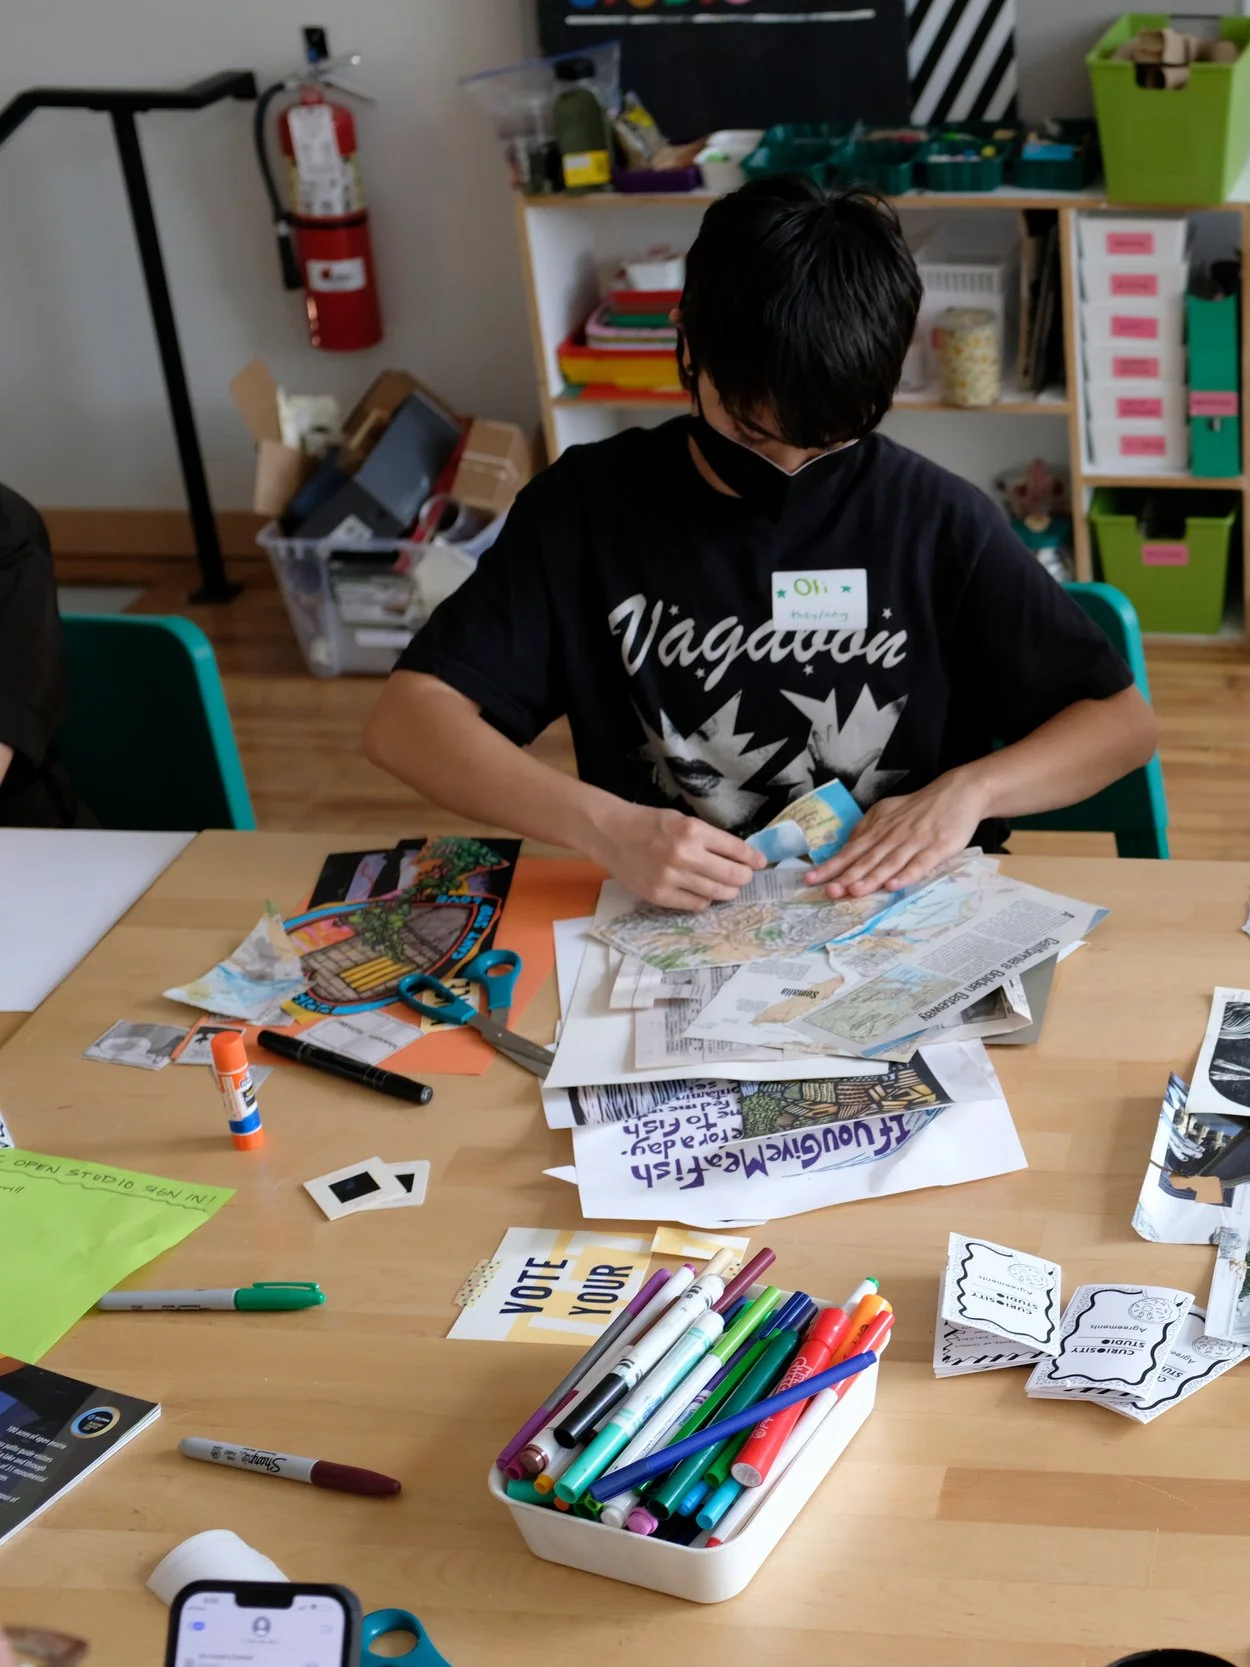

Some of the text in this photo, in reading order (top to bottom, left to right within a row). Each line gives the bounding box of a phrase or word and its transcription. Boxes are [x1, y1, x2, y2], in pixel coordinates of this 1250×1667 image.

[794, 577, 828, 596] Oli
[918, 937, 1060, 1022] California's Golden Gateway
[780, 988, 820, 999] Somalia
[680, 1135, 695, 1149] a
[873, 1114, 910, 1157] If
[703, 1153, 722, 1169] a
[766, 1134, 822, 1170] Give
[725, 1145, 769, 1179] Me
[13, 1159, 61, 1174] OPEN
[65, 1169, 135, 1190] STUDIO
[144, 1185, 183, 1200] SIGN
[499, 1257, 568, 1314] VOTE
[568, 1265, 633, 1315] YOUR
[971, 1293, 1032, 1315] CURIOSITY
[996, 1293, 1038, 1310] STUDIO
[1090, 1325, 1147, 1333] Agreements
[1071, 1347, 1135, 1356] CURIOSITY
[1101, 1339, 1146, 1348] STUDIO
[1169, 1351, 1196, 1364] Agree
[1161, 1366, 1184, 1378] STU
[241, 1452, 287, 1473] Sharpie
